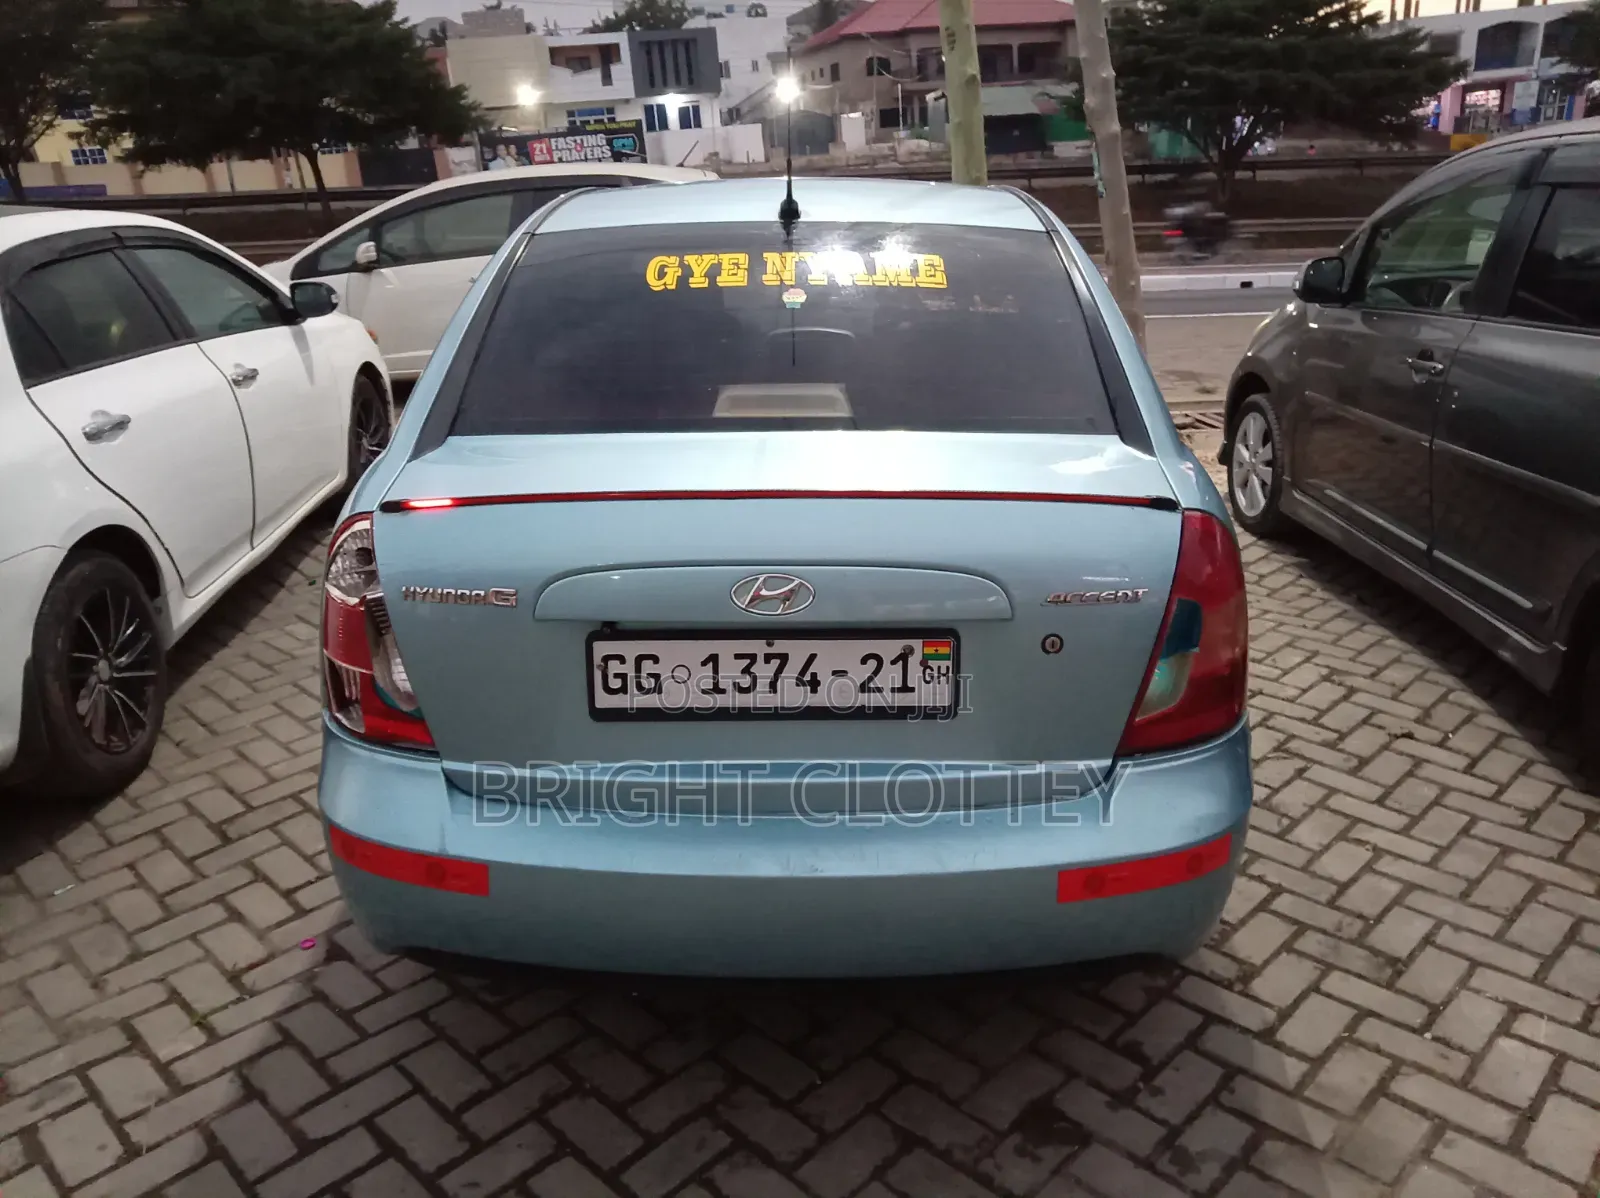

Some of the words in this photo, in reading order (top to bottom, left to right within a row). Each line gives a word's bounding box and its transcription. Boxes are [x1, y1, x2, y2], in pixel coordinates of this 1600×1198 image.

[533, 142, 547, 155] 21
[550, 133, 607, 150] FASTING
[552, 145, 612, 162] PRAYERS
[646, 252, 749, 290] GYE
[1046, 588, 1149, 604] ACCENT
[600, 653, 663, 696] GG
[700, 652, 916, 695] 1374-21
[922, 664, 950, 685] GH
